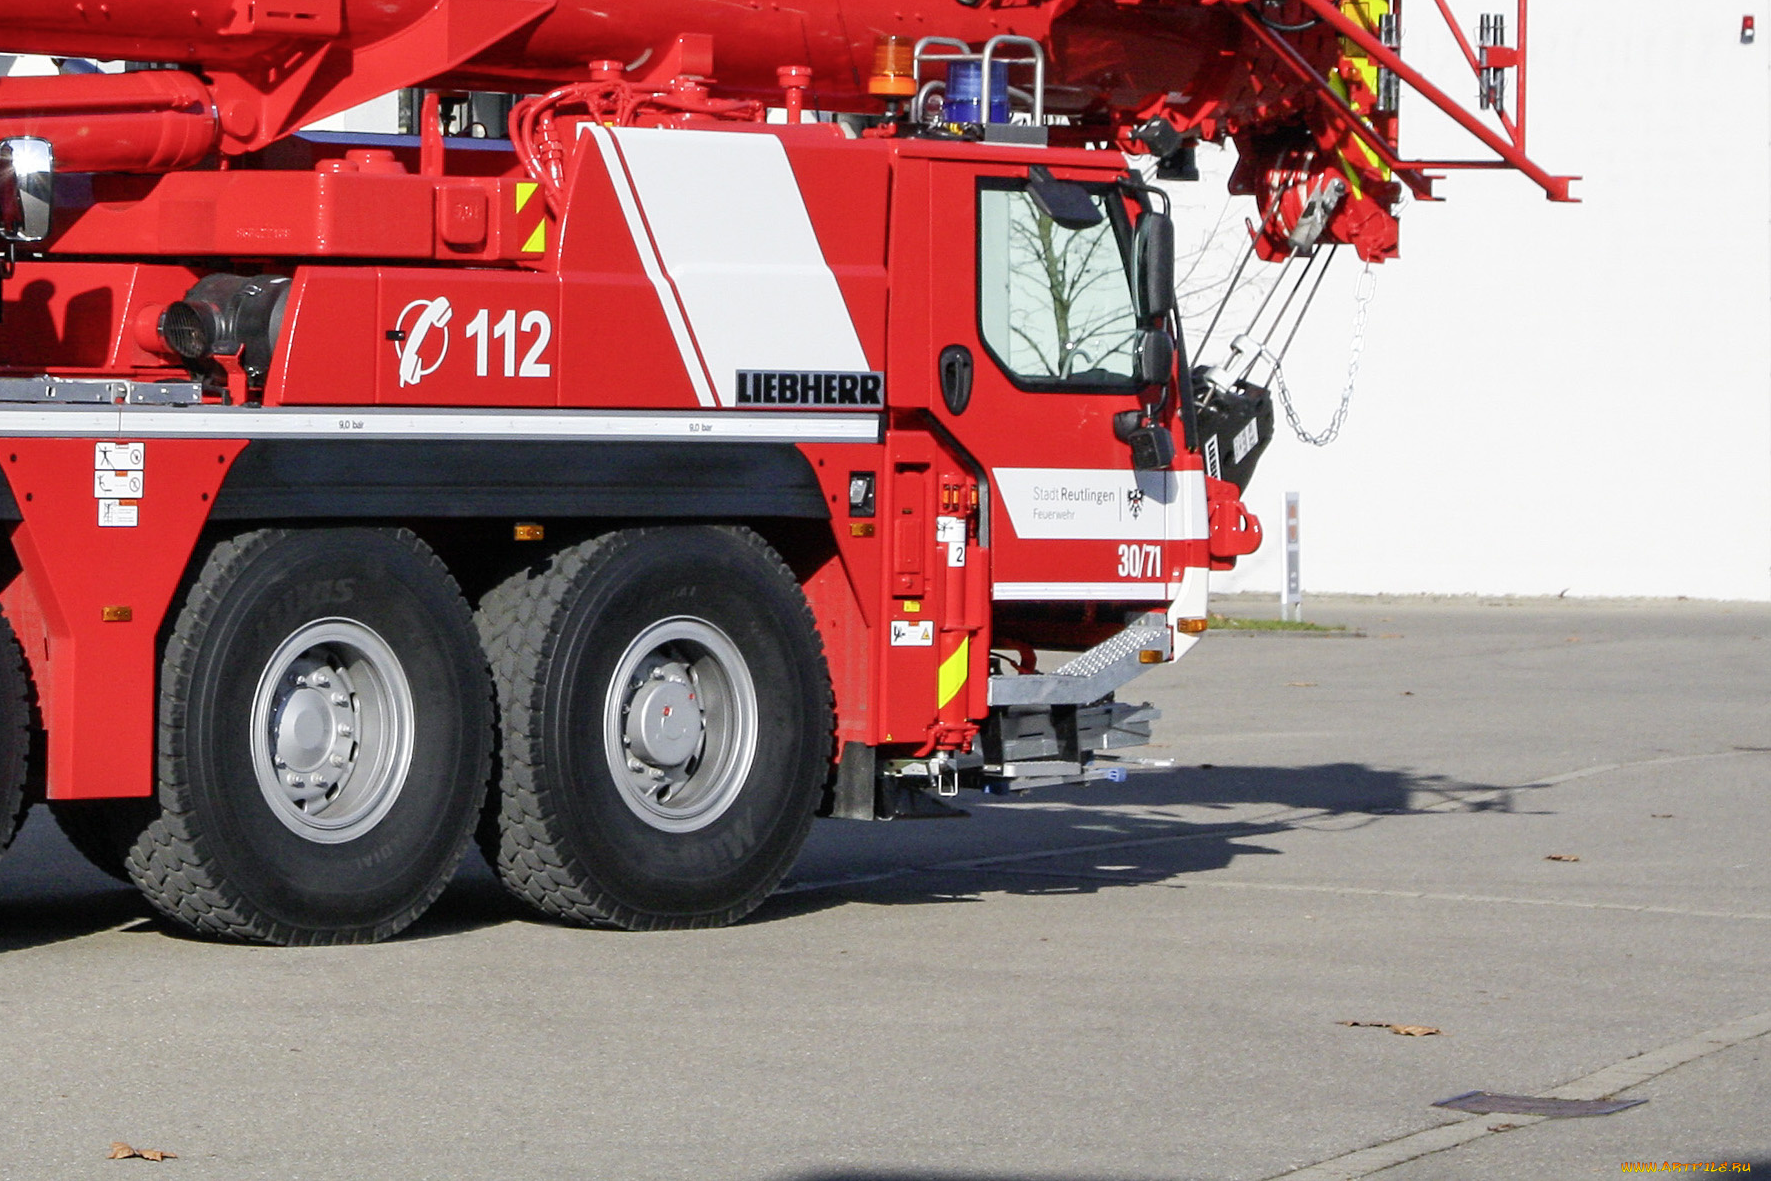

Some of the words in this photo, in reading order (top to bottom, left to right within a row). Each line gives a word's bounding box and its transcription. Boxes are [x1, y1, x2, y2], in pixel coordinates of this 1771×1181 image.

[465, 308, 551, 378] 112
[737, 372, 882, 406] LIEBHERR
[1033, 486, 1060, 502] Stadt
[1061, 486, 1115, 506] Reutlingen
[1033, 508, 1076, 521] Feuerwehr
[955, 546, 964, 563] 2
[1117, 543, 1162, 579] 30/71
